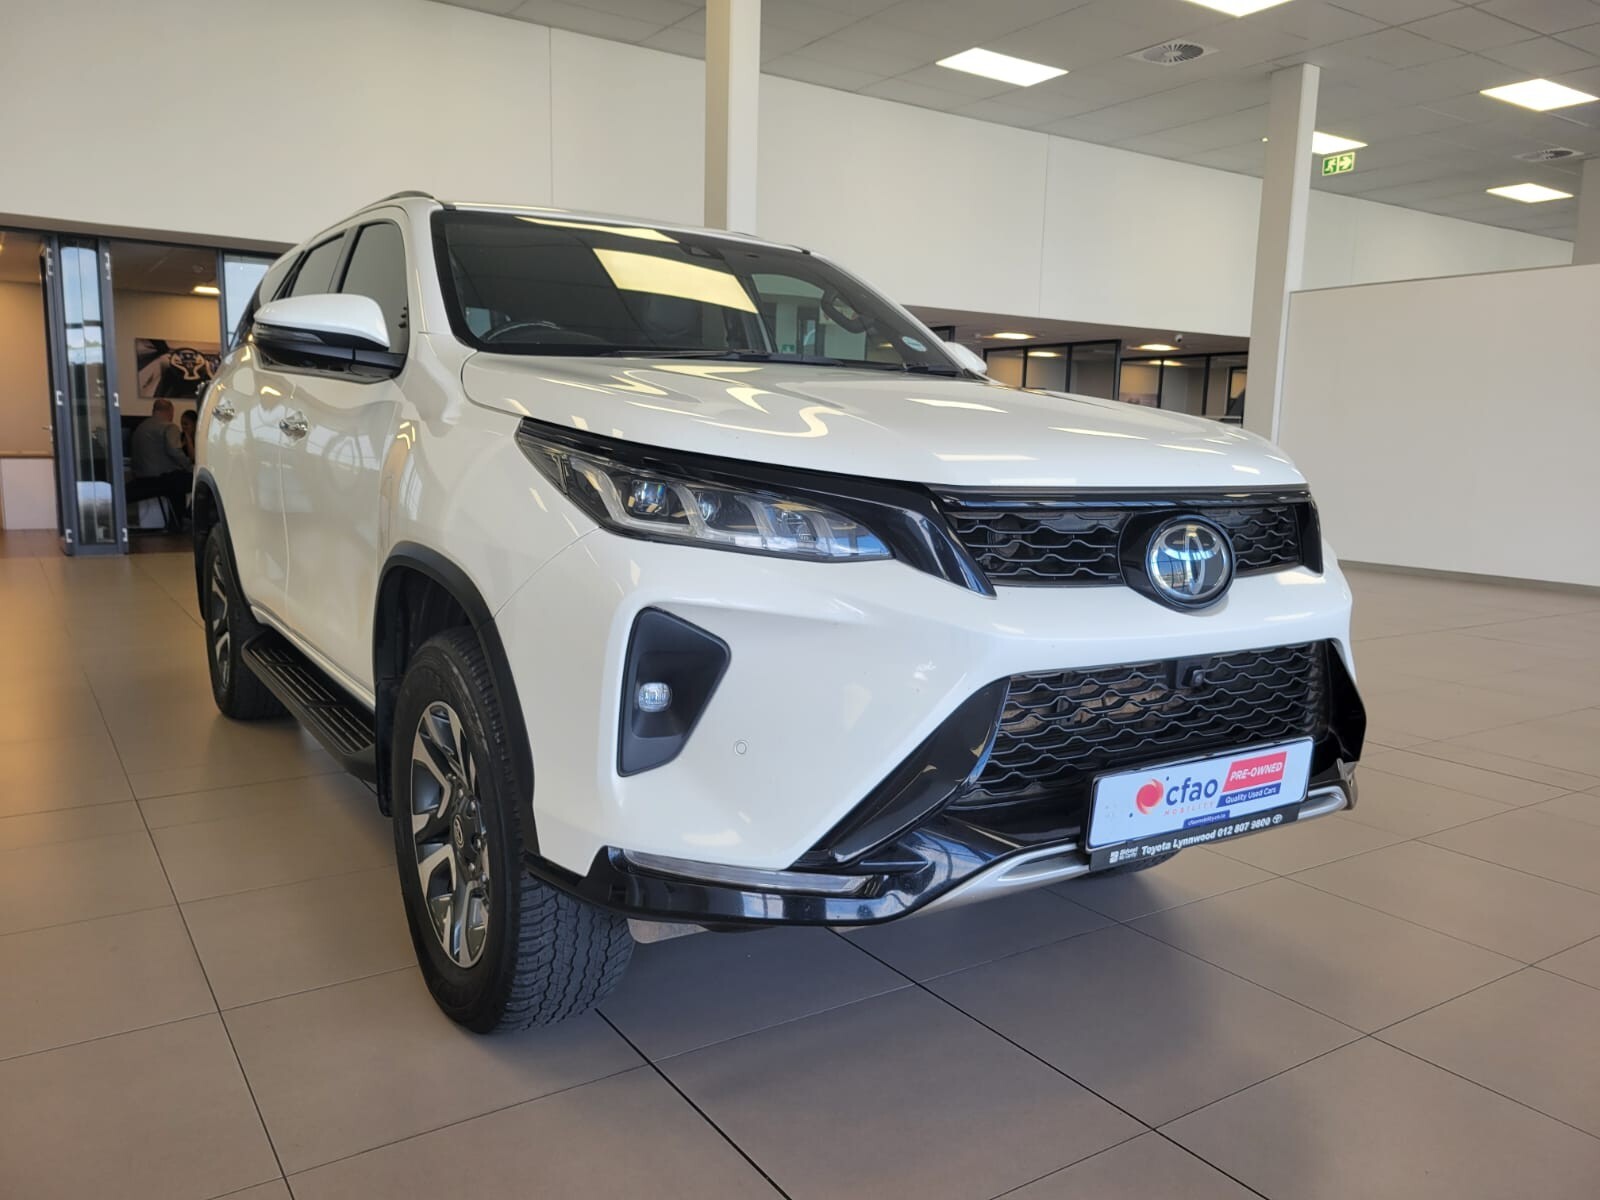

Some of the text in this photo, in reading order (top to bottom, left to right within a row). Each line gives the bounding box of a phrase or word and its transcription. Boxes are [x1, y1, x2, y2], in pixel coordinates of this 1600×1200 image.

[1230, 762, 1283, 781] PRE-OWNED
[1166, 777, 1218, 806] cfao
[1225, 786, 1277, 804] Quality Used Cars
[1142, 842, 1171, 856] Toyota
[1173, 830, 1216, 848] Lynnwood
[1217, 826, 1233, 837] 012
[1234, 822, 1250, 833] 807
[1251, 817, 1271, 830] 9800
